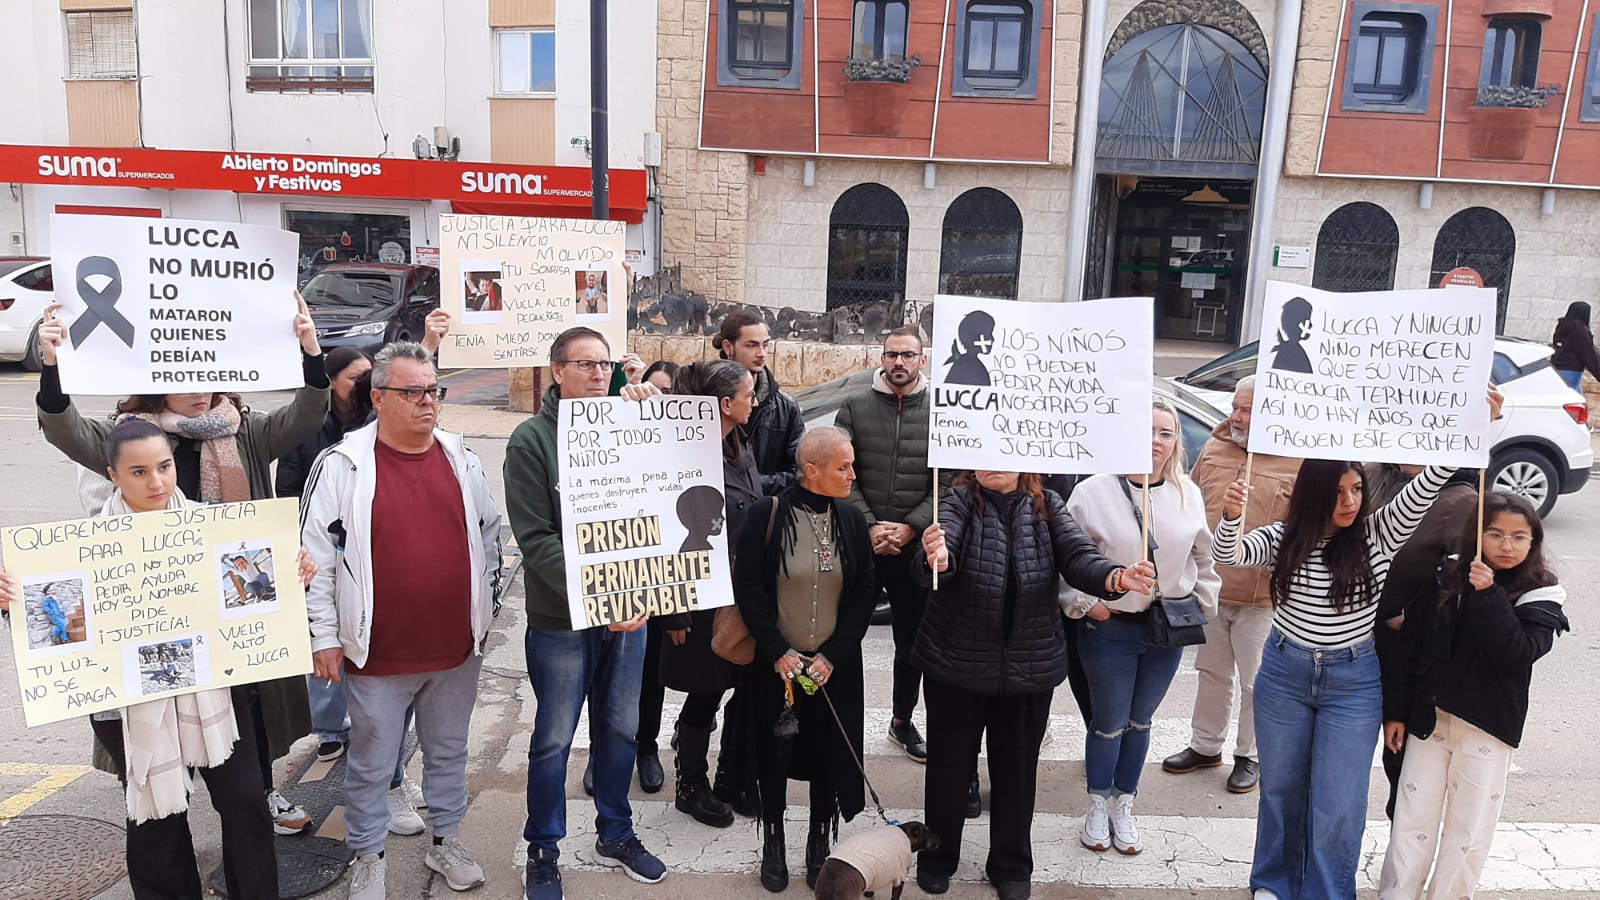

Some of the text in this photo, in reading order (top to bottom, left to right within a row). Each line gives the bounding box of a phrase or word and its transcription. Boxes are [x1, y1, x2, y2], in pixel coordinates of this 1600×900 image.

[38, 155, 174, 180] suma SUPERMERCADOS
[221, 155, 382, 176] Abierto Domingos
[253, 174, 342, 192] y Festivos
[461, 171, 594, 198] suma SUPERMERCAD
[521, 217, 568, 233] PARA
[148, 226, 240, 249] LUCCA
[457, 233, 549, 250] NI SILENCIO
[536, 246, 614, 262] NI OLVIDO
[149, 257, 275, 281] NO MURIÓ
[529, 262, 570, 275] SONRISA
[149, 283, 179, 300] LO
[149, 308, 232, 322] MATARON
[504, 298, 541, 311] VUELA
[150, 328, 226, 342] QUIENES
[1321, 310, 1482, 337] LUCCA Y NINGUN
[496, 332, 530, 345] MIEDO
[1001, 328, 1126, 354] LOS NIÑOS
[1319, 336, 1471, 360] NIÑO MERECEN
[150, 347, 216, 363] DEBÍAN
[494, 346, 539, 360] SENTIRSE
[993, 354, 1097, 374] NO PUEDEN
[152, 370, 260, 383] PROTEGERLO
[989, 370, 1105, 395] PEDIR AYUDA
[1318, 358, 1470, 384] QUE SU VIDA E
[934, 388, 999, 411] LUCCA
[1355, 385, 1467, 409] TERMINEN
[570, 399, 714, 427] POR LUCCA
[1294, 402, 1319, 421] NO
[1326, 405, 1360, 424] HAY
[1368, 407, 1413, 426] AÑOS
[1421, 413, 1459, 430] QUE
[567, 426, 705, 450] POR TODOS LOS
[992, 414, 1087, 439] QUEREMOS
[1265, 424, 1481, 452] PAGUEN ESTE CRIMEN
[931, 433, 942, 448] 4
[1000, 438, 1094, 461] JUSTICIA
[569, 449, 620, 468] NIÑOS
[568, 475, 583, 488] La
[642, 471, 668, 486] pena
[677, 469, 703, 484] para
[605, 486, 648, 499] destruyen
[658, 483, 684, 492] vidas
[163, 502, 256, 527] JUSTICIA
[576, 509, 660, 553] PRISIÓN
[79, 541, 123, 563] PARA
[93, 552, 204, 584] LUCCA NO PUDO
[581, 552, 710, 595] PERMANENTE
[95, 569, 186, 600] PEDIR AYUDA
[93, 582, 199, 616] HOY SU NOMBRE
[583, 583, 699, 626] REVISABLE
[131, 605, 168, 621] PIDE
[219, 621, 264, 641] VUELA
[232, 634, 266, 651] ALTO
[27, 656, 98, 678] TU LUZ
[247, 647, 289, 666] LUCCA
[25, 677, 79, 702] NO SE
[67, 686, 117, 709] APAGA
